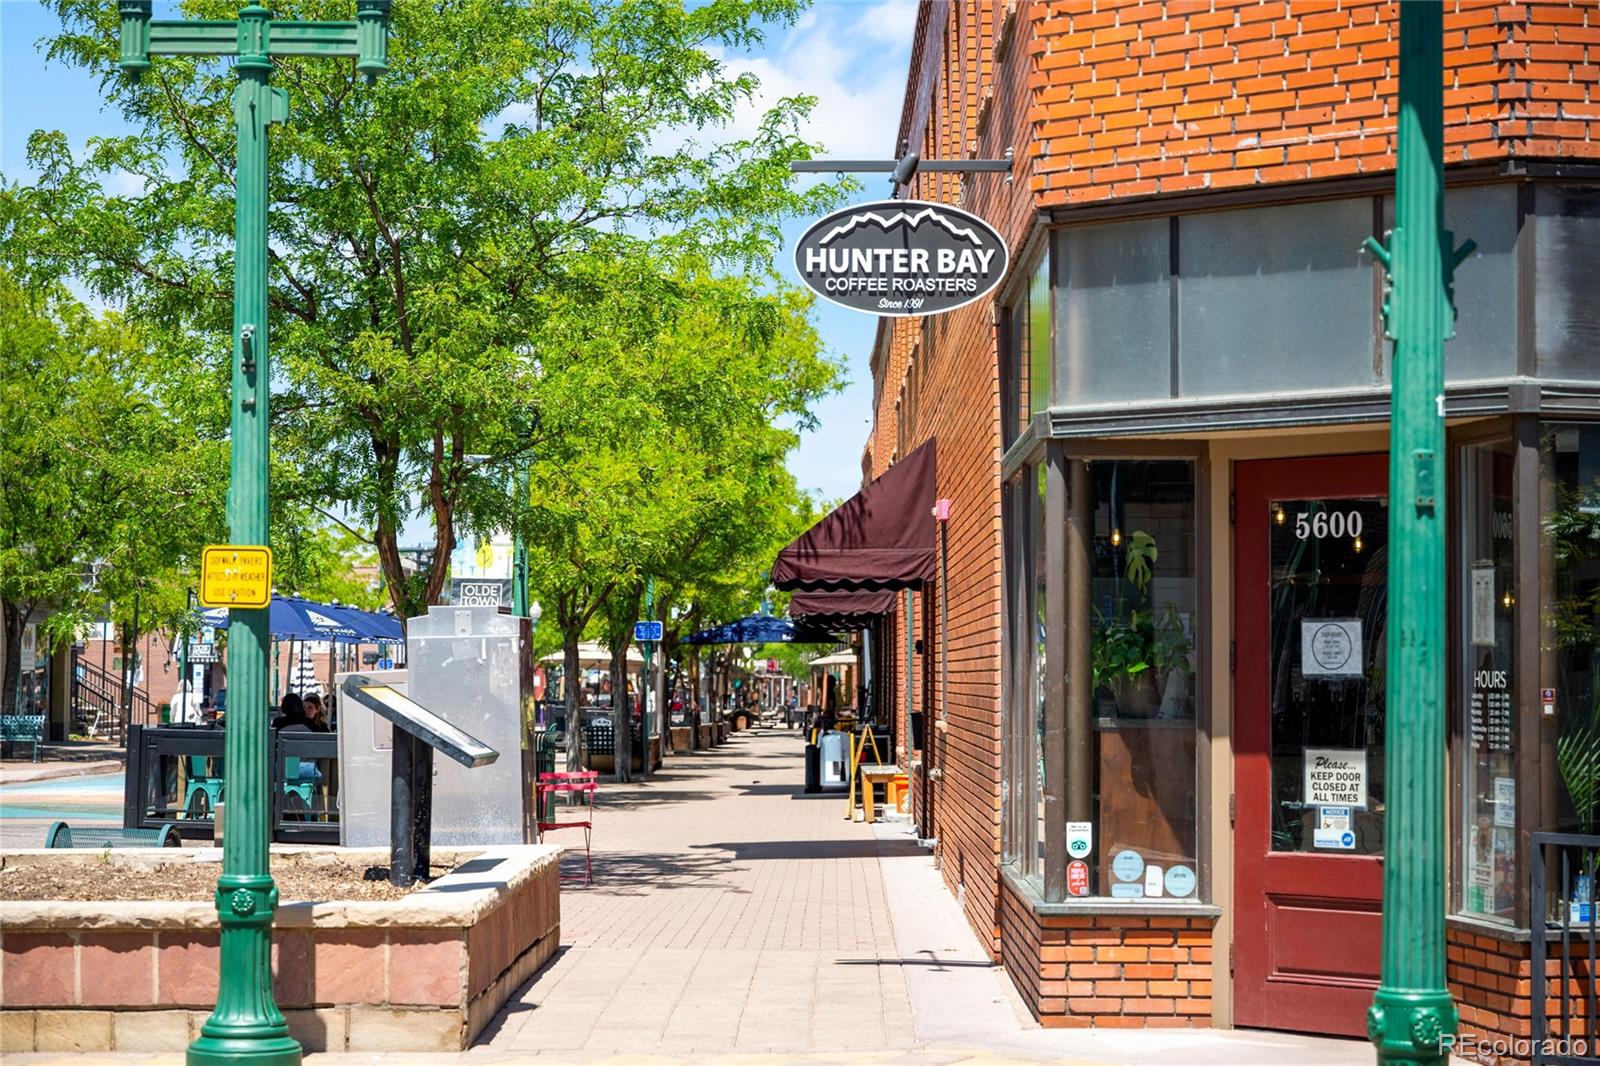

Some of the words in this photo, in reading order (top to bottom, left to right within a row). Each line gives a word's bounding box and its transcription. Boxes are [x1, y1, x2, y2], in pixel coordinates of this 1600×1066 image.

[805, 247, 930, 274] HUNTER
[937, 248, 996, 274] BAY
[825, 277, 888, 292] COFFEE
[892, 277, 977, 292] ROASTERS
[877, 297, 903, 309] Since
[903, 298, 925, 309] 1991
[1295, 510, 1363, 539] 5600
[240, 572, 265, 582] WEATHER
[464, 585, 498, 596] OLDE
[462, 596, 500, 606] TOWN
[1473, 670, 1507, 689] HOURS
[1314, 756, 1357, 770] Please...
[1310, 771, 1334, 781] KEEP
[1336, 772, 1361, 782] DOOR
[1312, 782, 1347, 792] CLOSED
[1349, 783, 1360, 792] AT
[1312, 793, 1329, 802] ALL
[1331, 793, 1359, 803] TIMES
